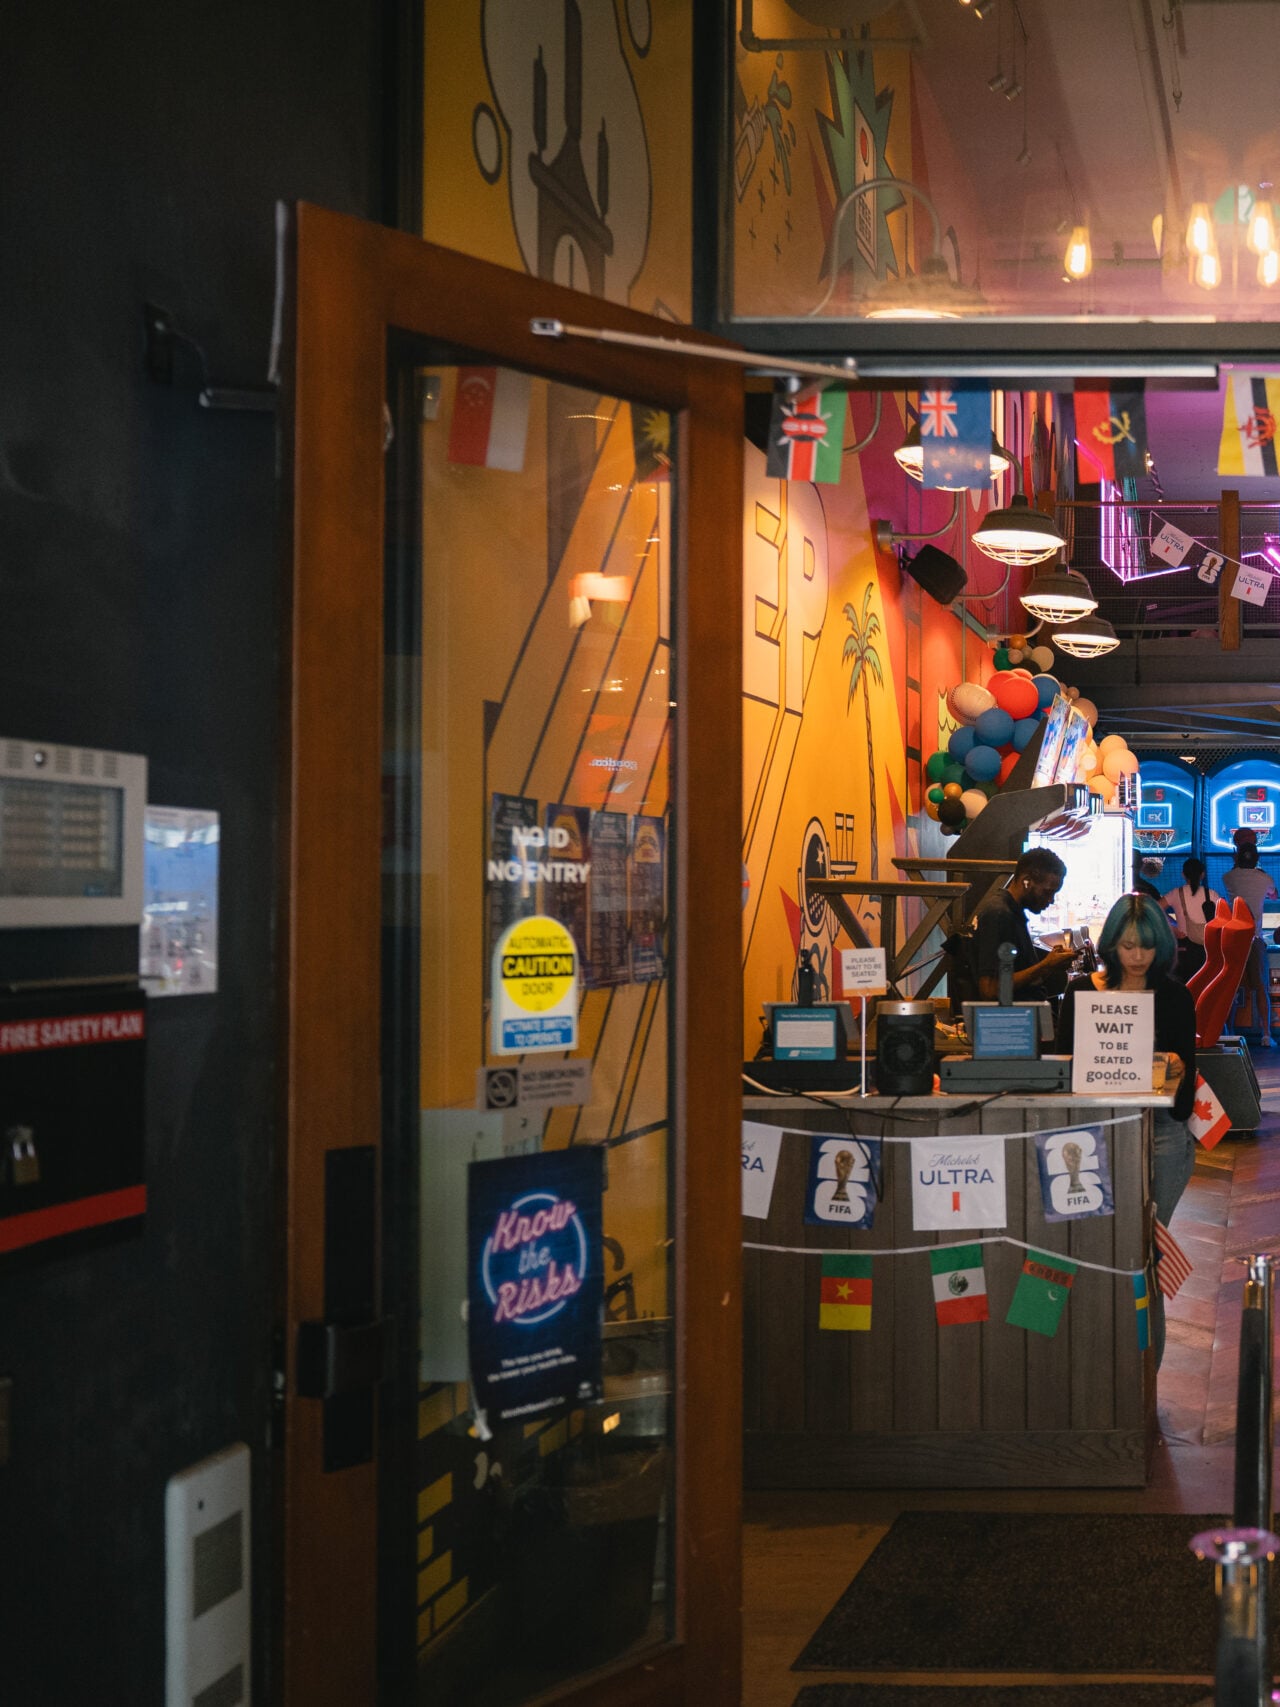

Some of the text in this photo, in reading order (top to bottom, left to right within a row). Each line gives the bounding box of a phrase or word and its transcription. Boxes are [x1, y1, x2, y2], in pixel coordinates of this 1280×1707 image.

[1161, 534, 1184, 552] ULTRA
[1239, 577, 1265, 590] ULTRA
[512, 826, 571, 849] NO ID
[487, 861, 592, 884] NO ENTRY
[509, 936, 569, 949] AUTOMATIC
[503, 956, 573, 977] CAUTION
[522, 982, 554, 995] DOOR
[1092, 1004, 1138, 1015] PLEASE
[0, 1014, 141, 1050] FIRE SAFETY PLAN
[1095, 1022, 1133, 1034] WAIT
[1099, 1042, 1129, 1051] TO BE
[1094, 1056, 1133, 1064] SEATED
[1086, 1068, 1141, 1083] goodco.
[928, 1153, 980, 1168] Michelob
[920, 1168, 995, 1186] ULTRA
[1067, 1196, 1091, 1207] FIFA
[828, 1204, 852, 1215] FIFA
[492, 1201, 577, 1254] Know
[518, 1241, 552, 1275] the
[495, 1260, 582, 1323] Risks
